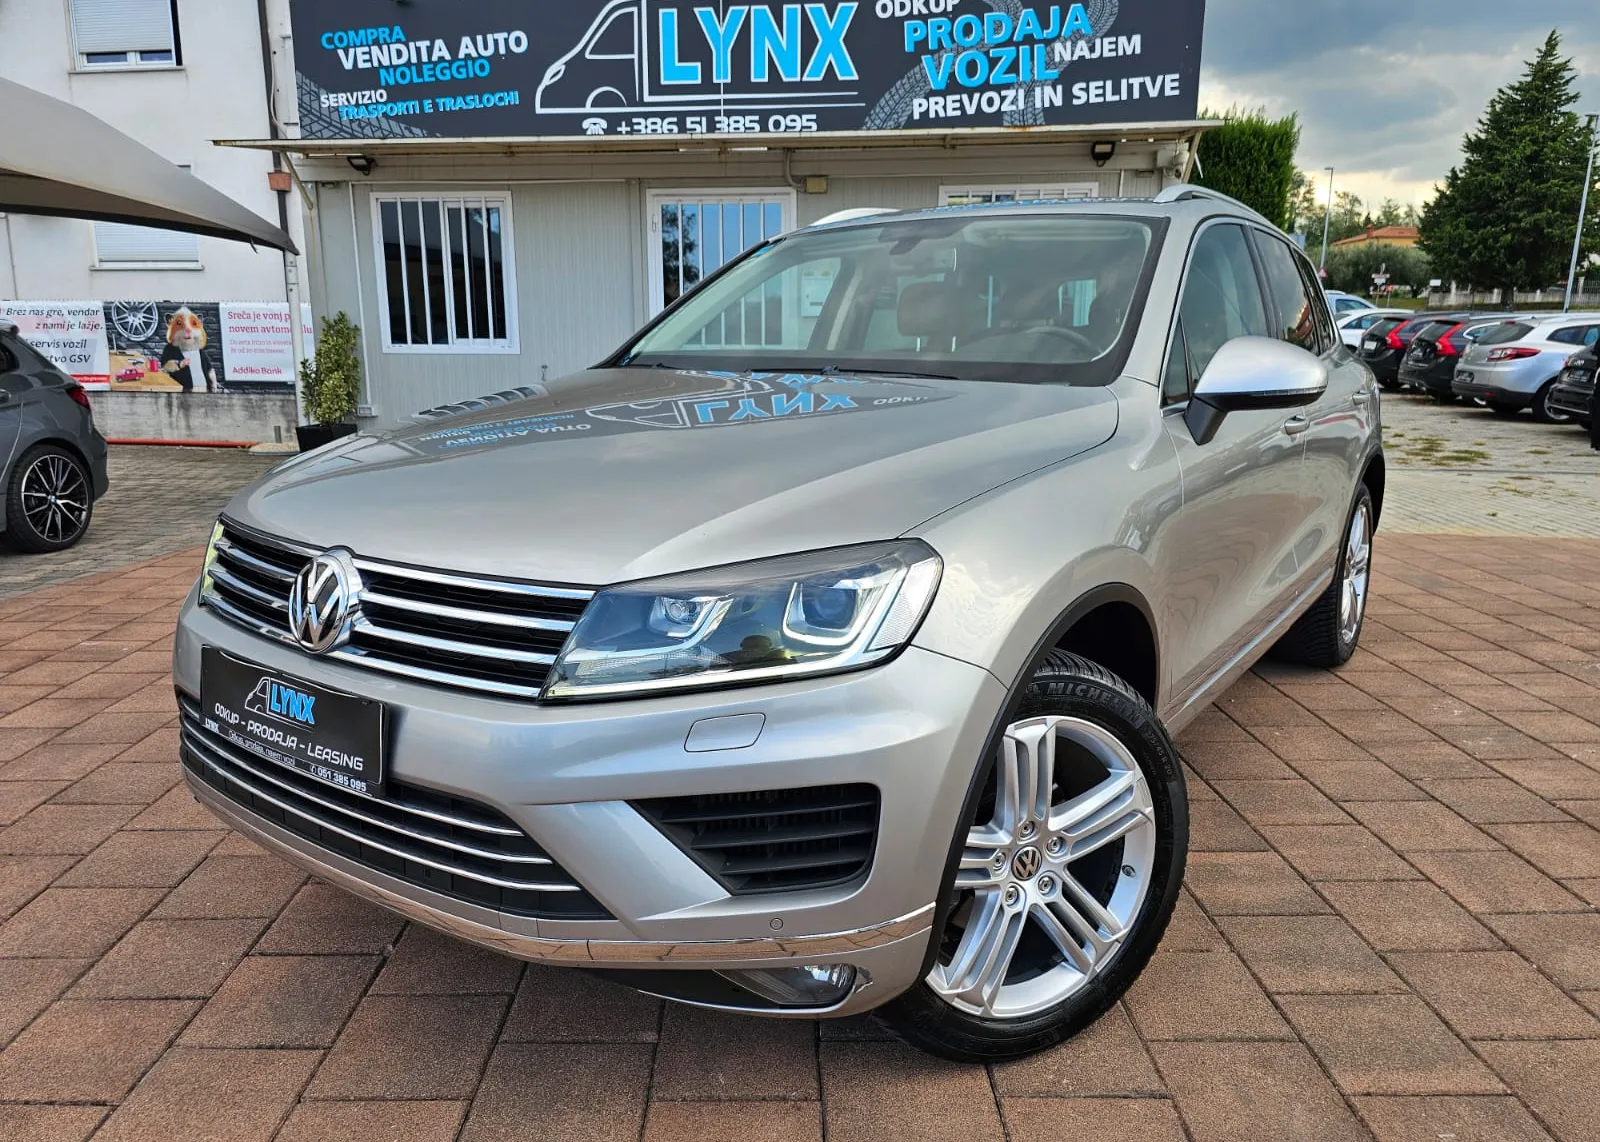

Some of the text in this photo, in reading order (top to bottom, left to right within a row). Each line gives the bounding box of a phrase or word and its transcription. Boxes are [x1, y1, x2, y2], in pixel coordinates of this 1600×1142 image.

[875, 0, 960, 19] ODKUP
[321, 25, 406, 49] COMPRA
[904, 4, 1093, 52] PRODAJA
[337, 30, 529, 70] VENDITA AUTO
[658, 2, 859, 85] LYNX
[1054, 34, 1141, 62] NAJEM
[379, 58, 490, 86] NOLEGGIO
[921, 43, 1059, 91] VOZIL
[320, 89, 387, 108] SERVIZIO
[338, 90, 519, 120] TRASPORTI E TRASLOCHI
[912, 73, 1180, 120] PREVOZI IN SELITVE
[617, 114, 818, 134] +386 51 385 095
[6, 307, 100, 319] Brez nas gre, vendar
[227, 310, 251, 320] Sreča
[252, 311, 261, 321] je
[43, 321, 66, 330] nami
[66, 321, 76, 331] je
[229, 325, 259, 333] novem
[63, 339, 87, 349] vozil
[69, 354, 91, 364] GSV
[232, 366, 282, 375] Addiko Bank
[271, 683, 316, 725] LYNX
[214, 702, 239, 726] ODKUP
[247, 719, 298, 750] PRODAJA
[307, 741, 364, 771] LEASING
[317, 767, 331, 780] 051
[333, 772, 349, 786] 385
